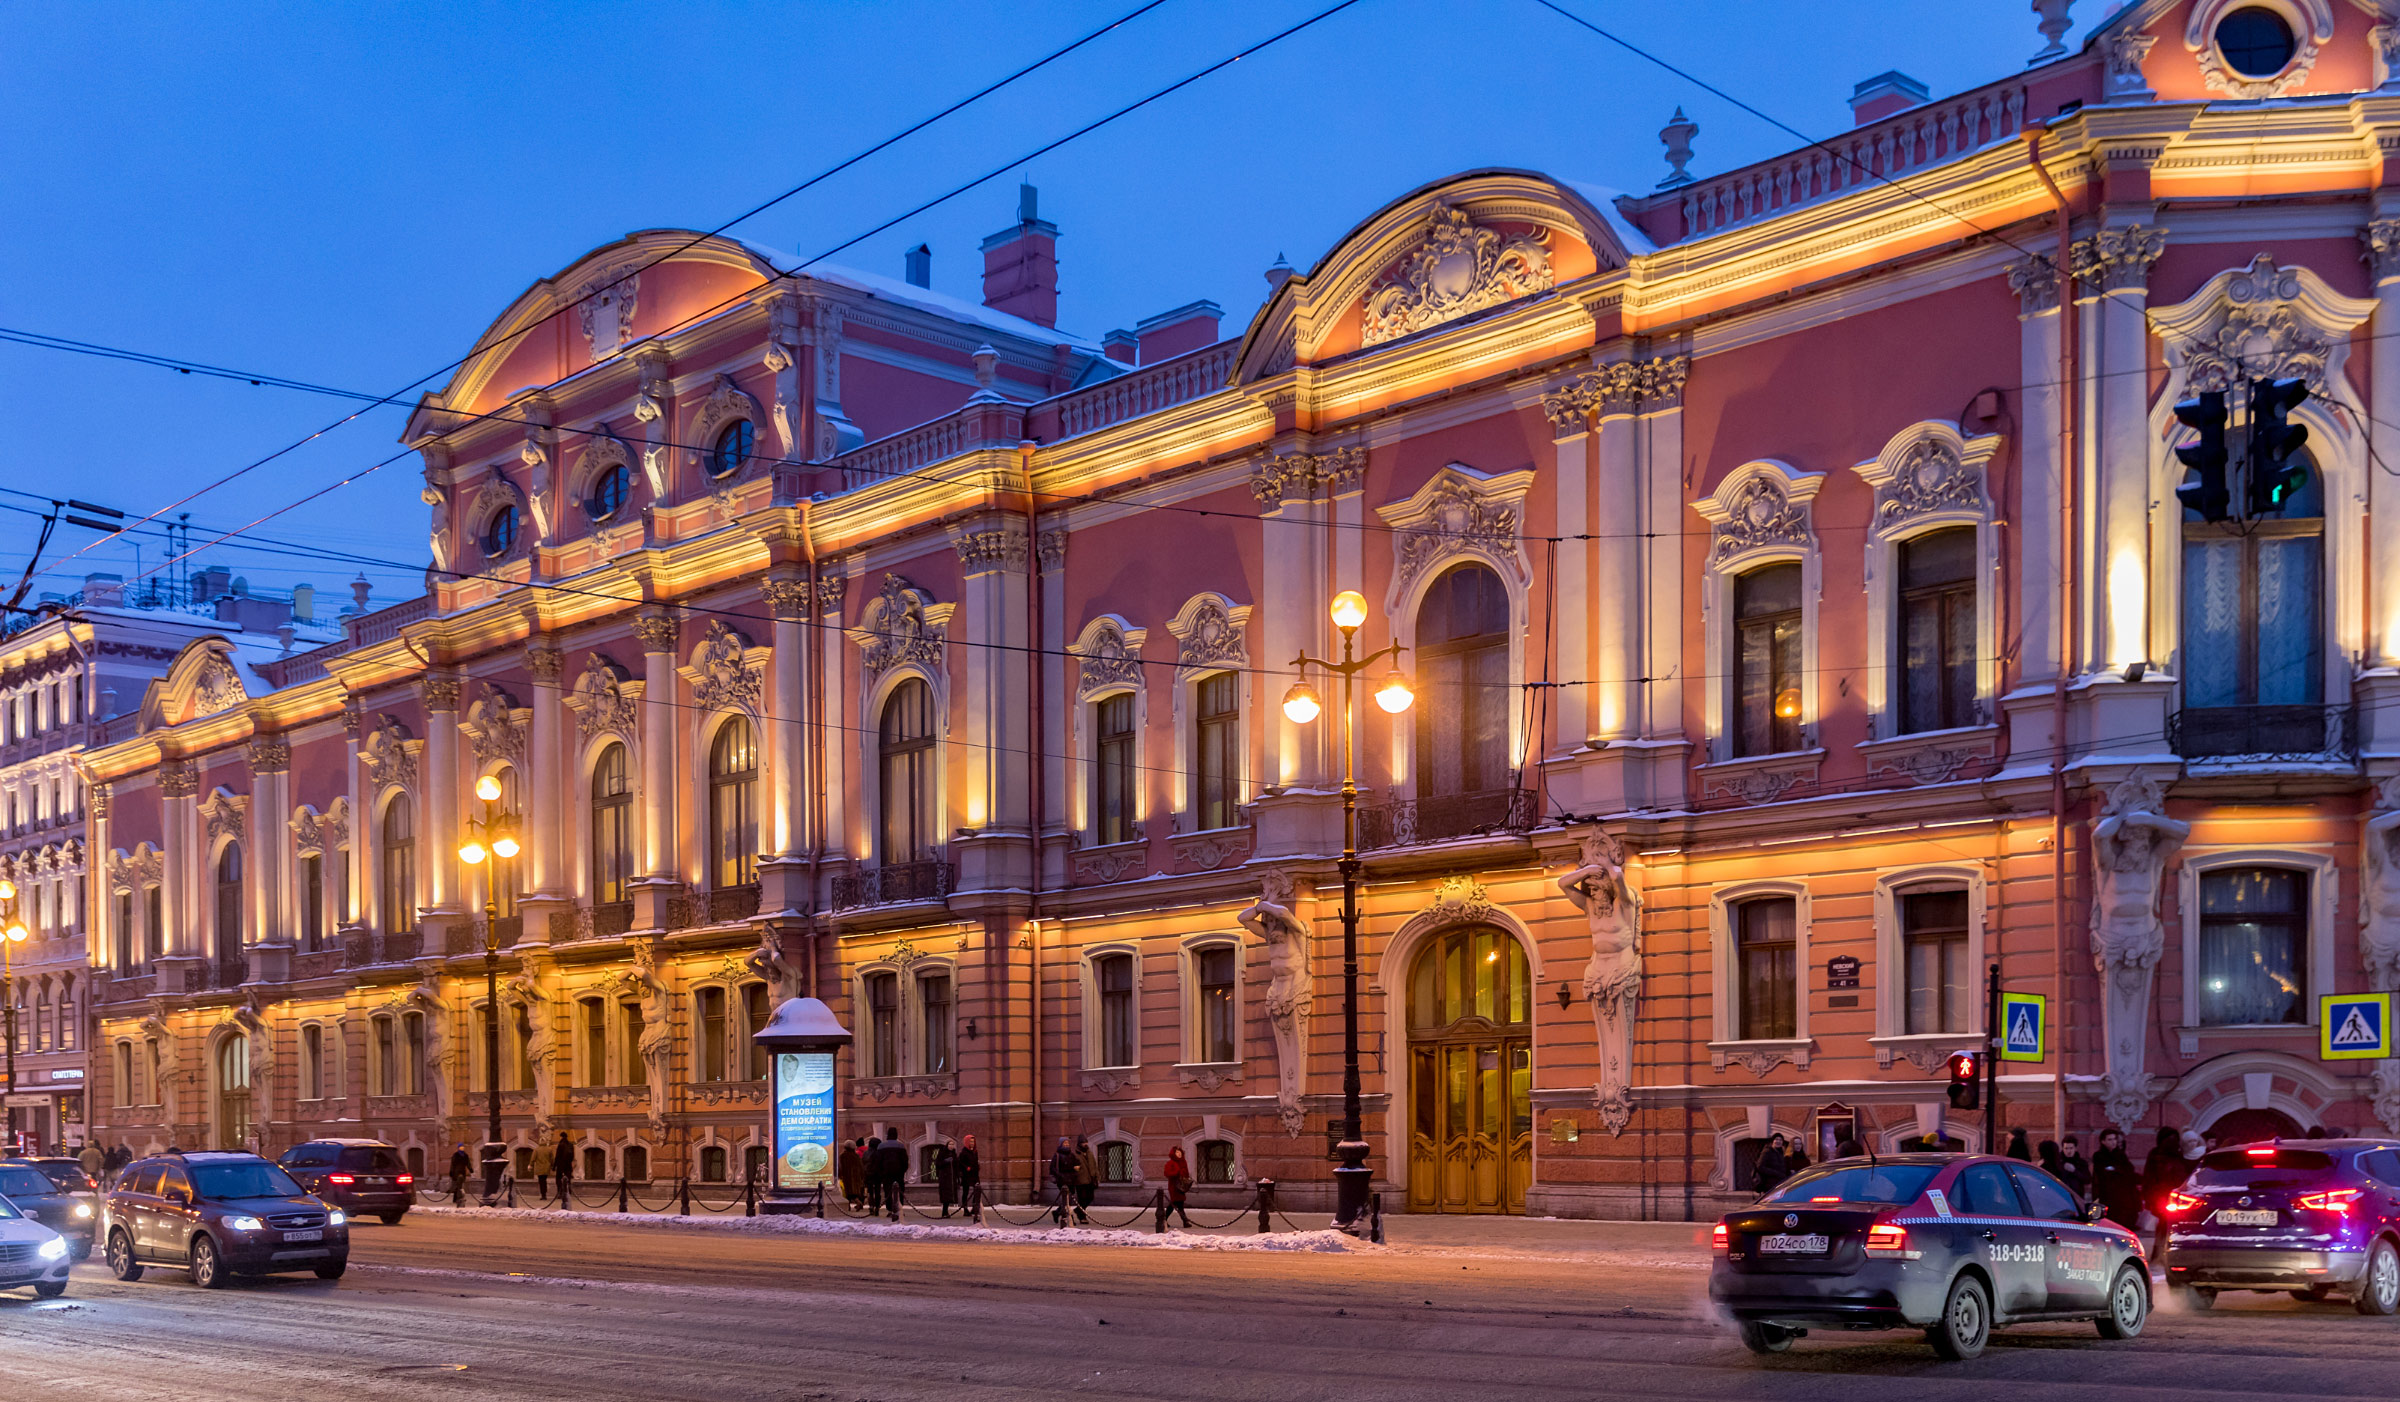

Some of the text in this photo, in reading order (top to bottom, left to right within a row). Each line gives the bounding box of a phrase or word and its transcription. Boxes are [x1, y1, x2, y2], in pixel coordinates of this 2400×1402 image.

[792, 1097, 822, 1106] МУЗЕЙ
[780, 1108, 832, 1116] СТАНОВЛЕНИЯ
[781, 1116, 832, 1126] ДЕМОКРАТИИ
[27, 1136, 38, 1157] OFT
[1808, 1236, 1826, 1247] 178
[1989, 1244, 2045, 1262] 318-0-318
[2066, 1268, 2085, 1281] ЗАКАЗ
